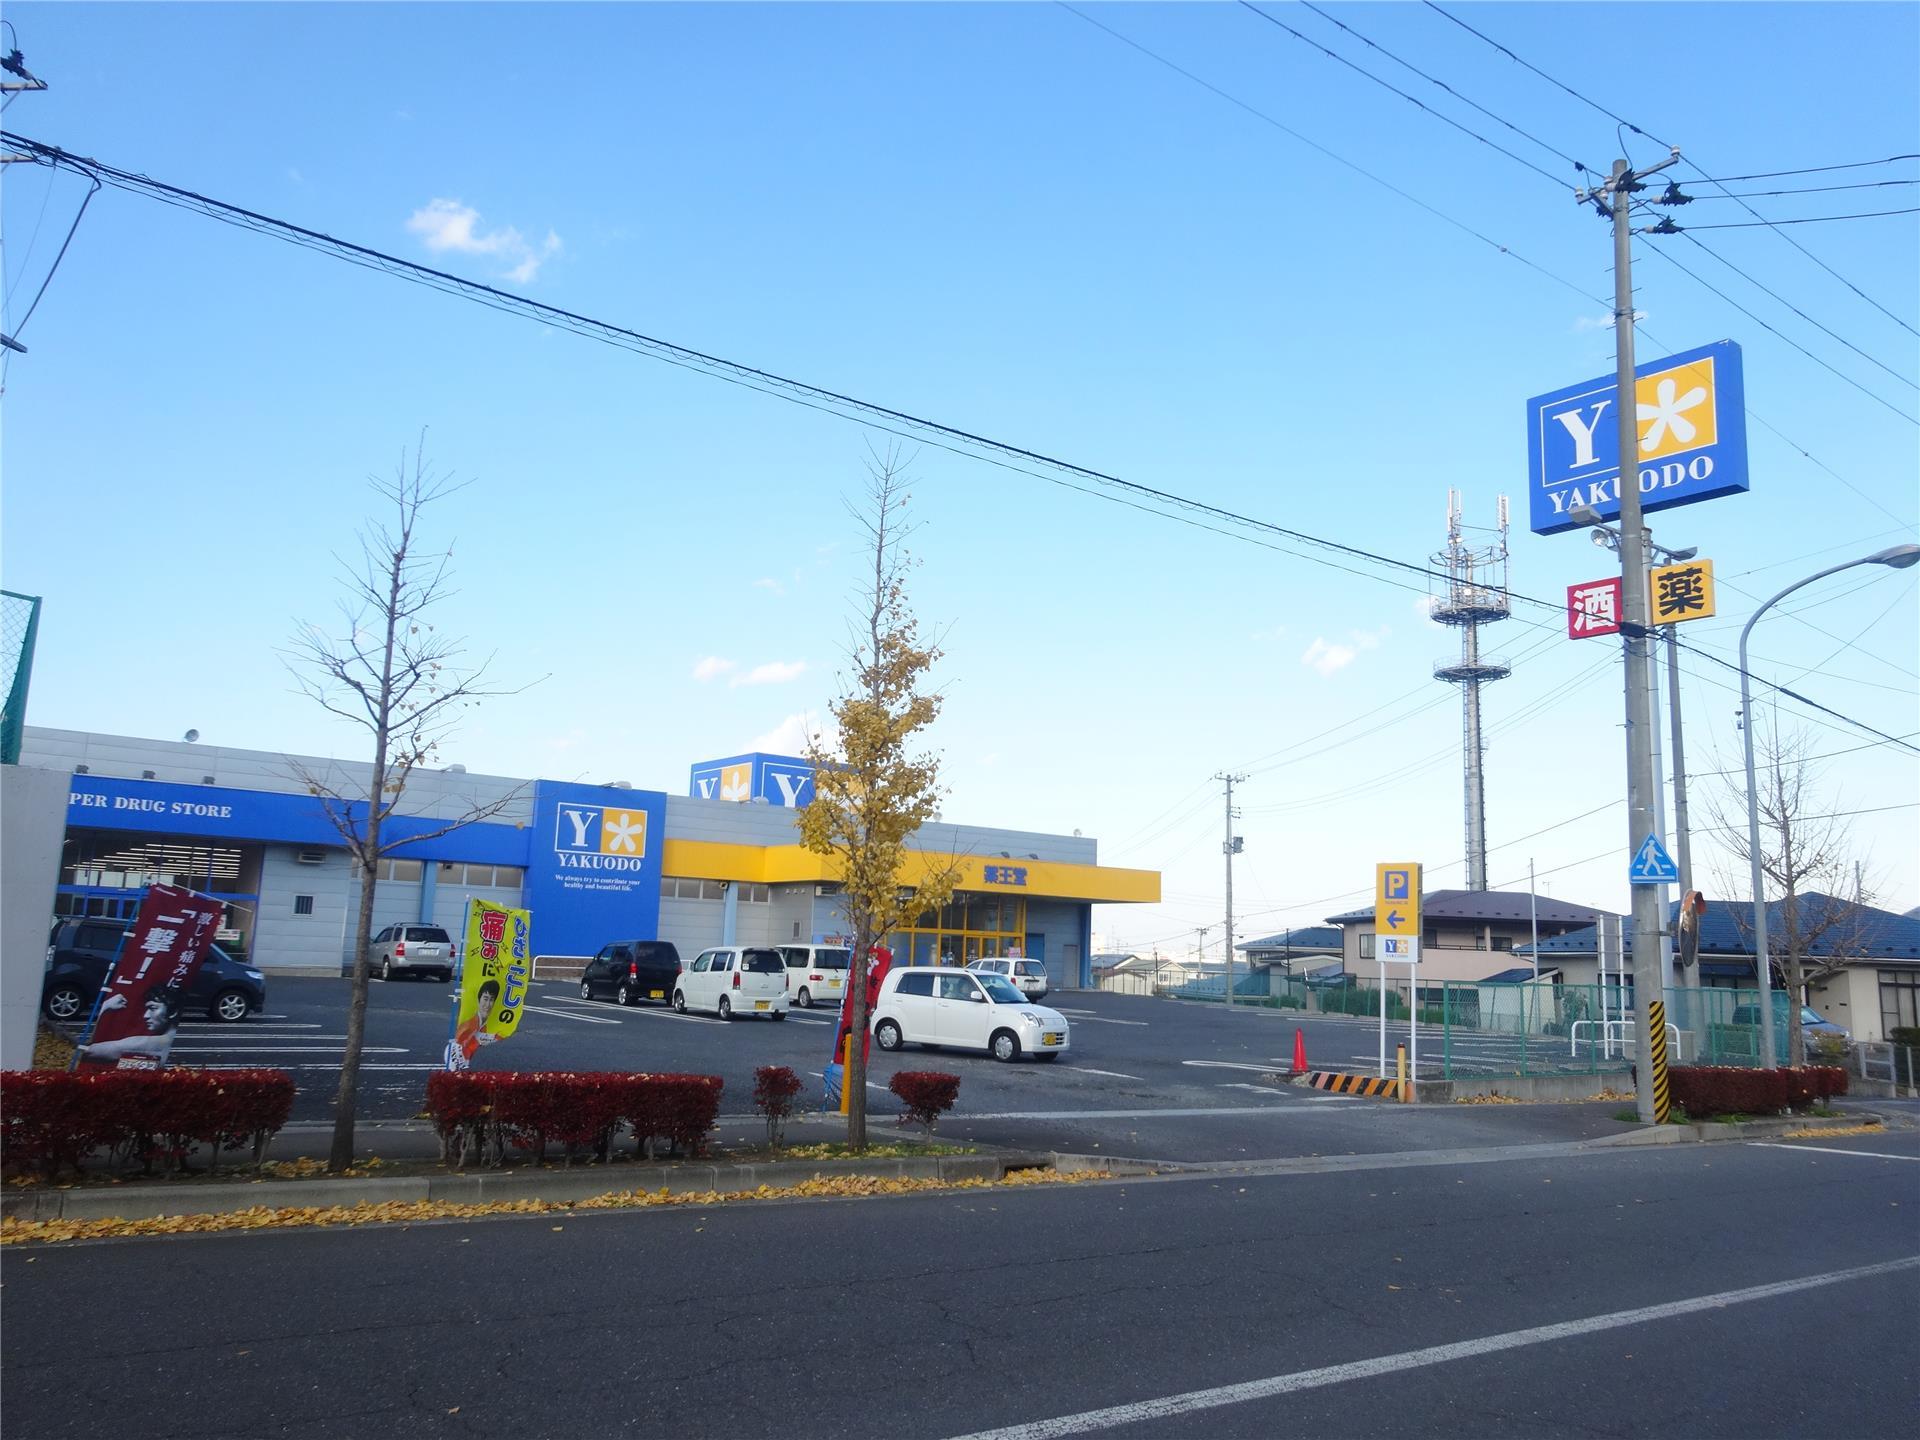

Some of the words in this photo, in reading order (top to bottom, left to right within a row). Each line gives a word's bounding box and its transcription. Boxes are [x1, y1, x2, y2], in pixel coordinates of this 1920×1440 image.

[1553, 400, 1611, 468] Y
[1573, 584, 1616, 632] 酒
[1658, 567, 1706, 617] 薬
[114, 796, 166, 813] DRUG
[171, 802, 232, 818] STORE
[563, 809, 598, 847] Y
[558, 853, 642, 871] YAKUODO
[564, 875, 583, 883] always
[564, 882, 583, 890] healthy
[1389, 873, 1405, 897] P
[167, 911, 214, 989] 激しい痛みに
[480, 910, 508, 978] 痛みに
